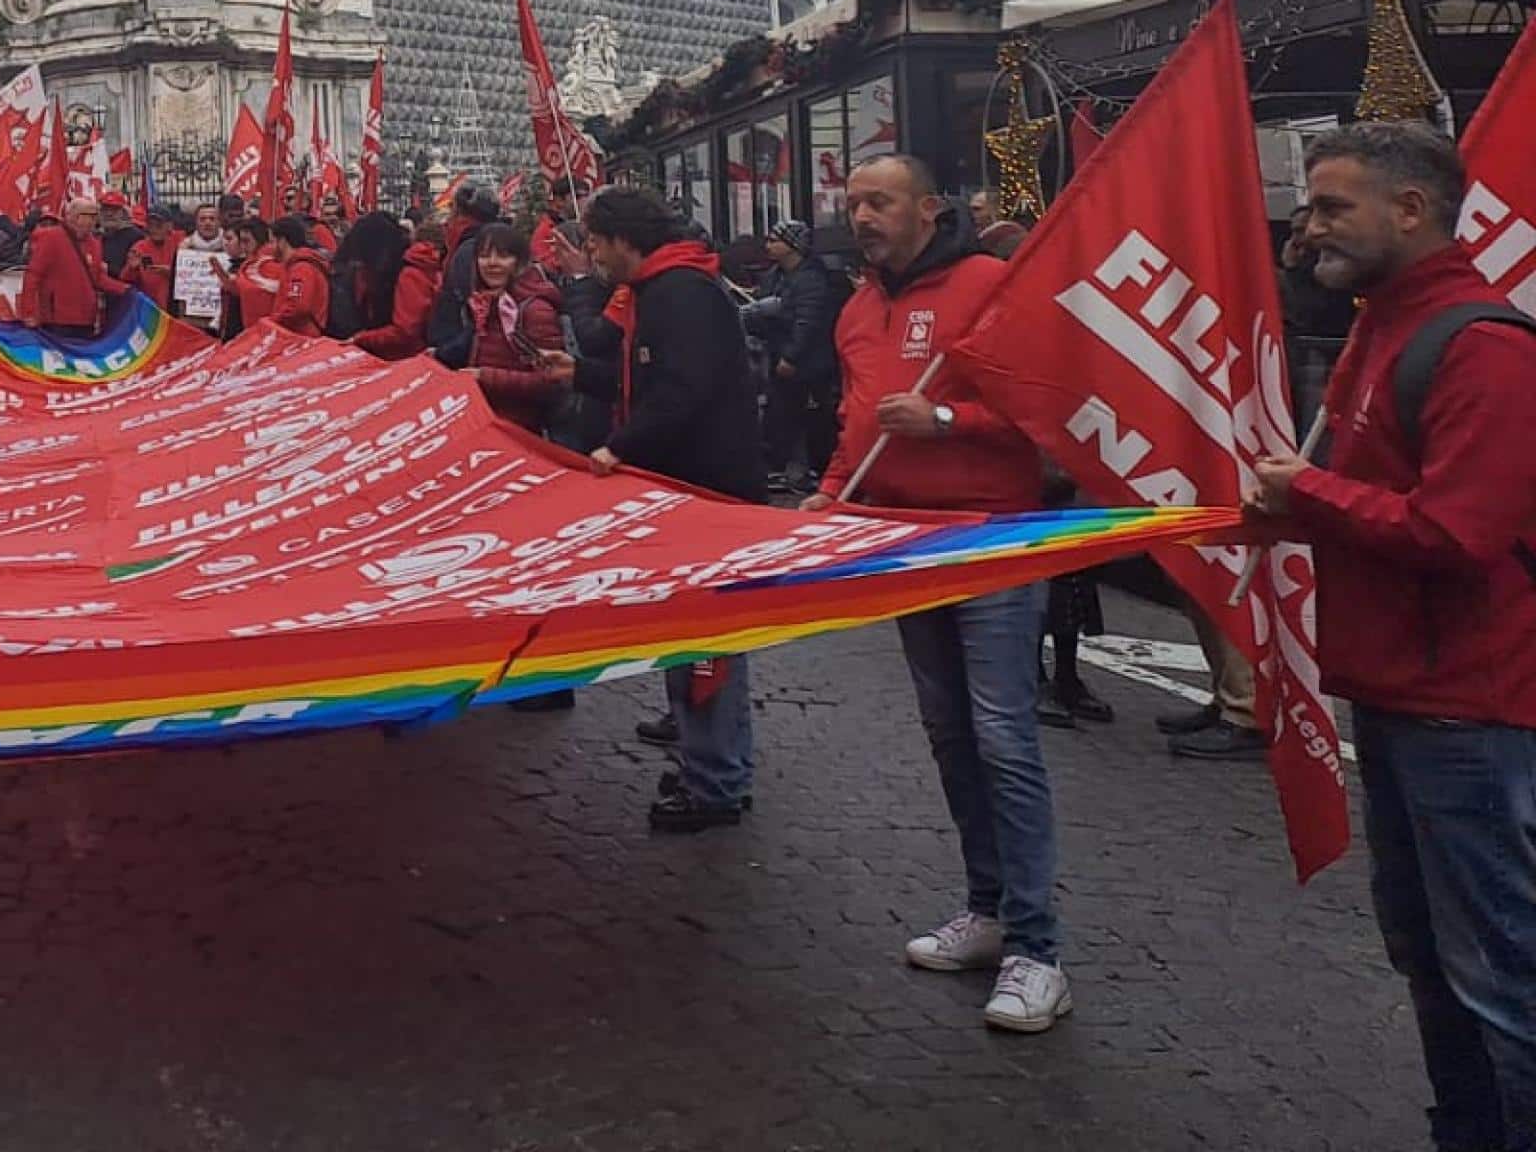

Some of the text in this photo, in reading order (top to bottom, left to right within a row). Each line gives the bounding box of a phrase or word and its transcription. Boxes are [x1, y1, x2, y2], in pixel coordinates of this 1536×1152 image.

[42, 327, 150, 376] PACE
[137, 469, 326, 545] FILLEA
[344, 394, 467, 463] CGIL
[278, 450, 507, 552] CASERTA
